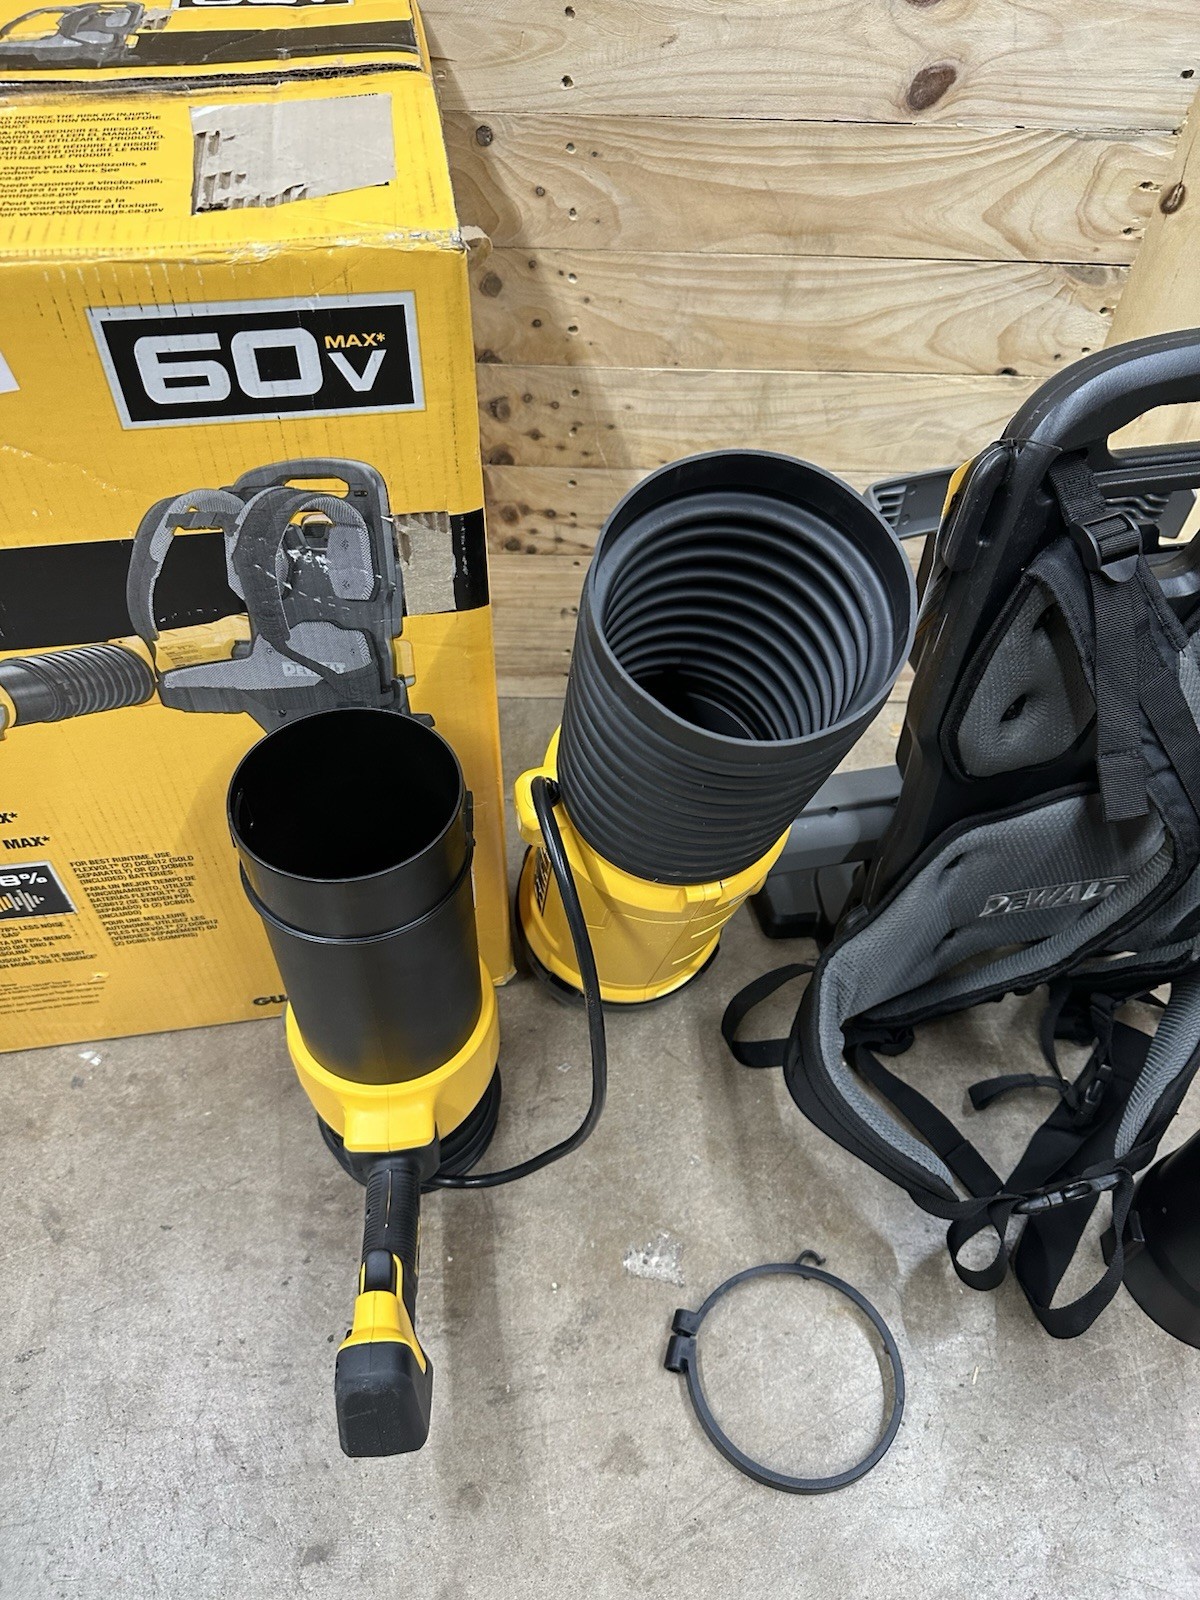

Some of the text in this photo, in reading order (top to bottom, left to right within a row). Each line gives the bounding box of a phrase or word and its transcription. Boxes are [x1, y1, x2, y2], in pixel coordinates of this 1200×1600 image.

[112, 854, 153, 863] RUNTIME,
[76, 868, 134, 880] SEPARATELY)
[160, 862, 194, 870] DCB615
[80, 875, 128, 886] (INCLUDED)
[122, 880, 151, 888] MEJOR
[153, 876, 184, 886] TIEMPO
[978, 878, 1125, 917] DEWALT
[253, 994, 289, 1006] GU
